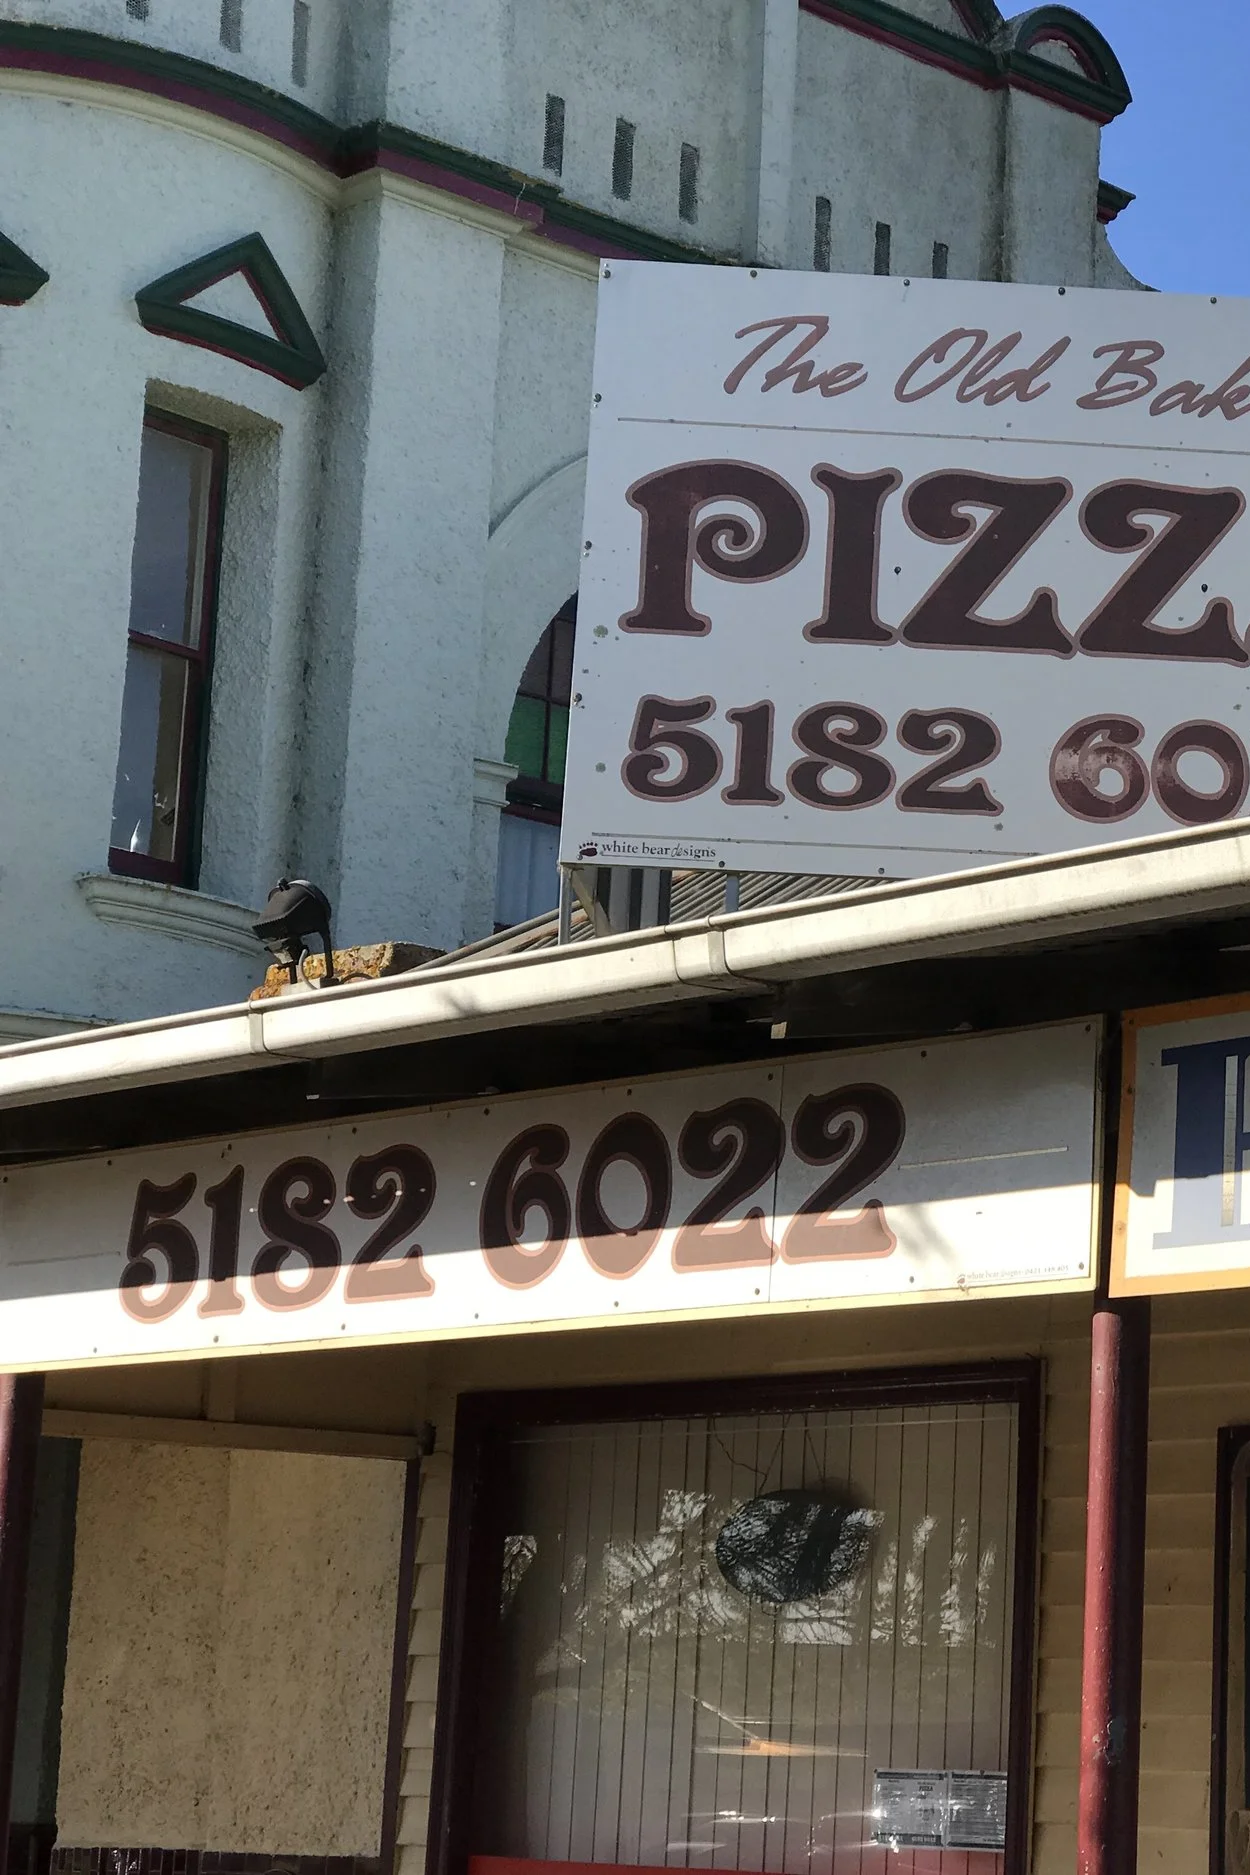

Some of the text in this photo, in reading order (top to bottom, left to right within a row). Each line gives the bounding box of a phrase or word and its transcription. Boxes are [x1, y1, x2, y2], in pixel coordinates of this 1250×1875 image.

[723, 315, 868, 398] The
[894, 327, 1072, 406] Old
[621, 694, 1004, 818] 5182
[602, 840, 639, 854] white
[642, 842, 670, 856] bear
[119, 1082, 907, 1325] 5182 6022
